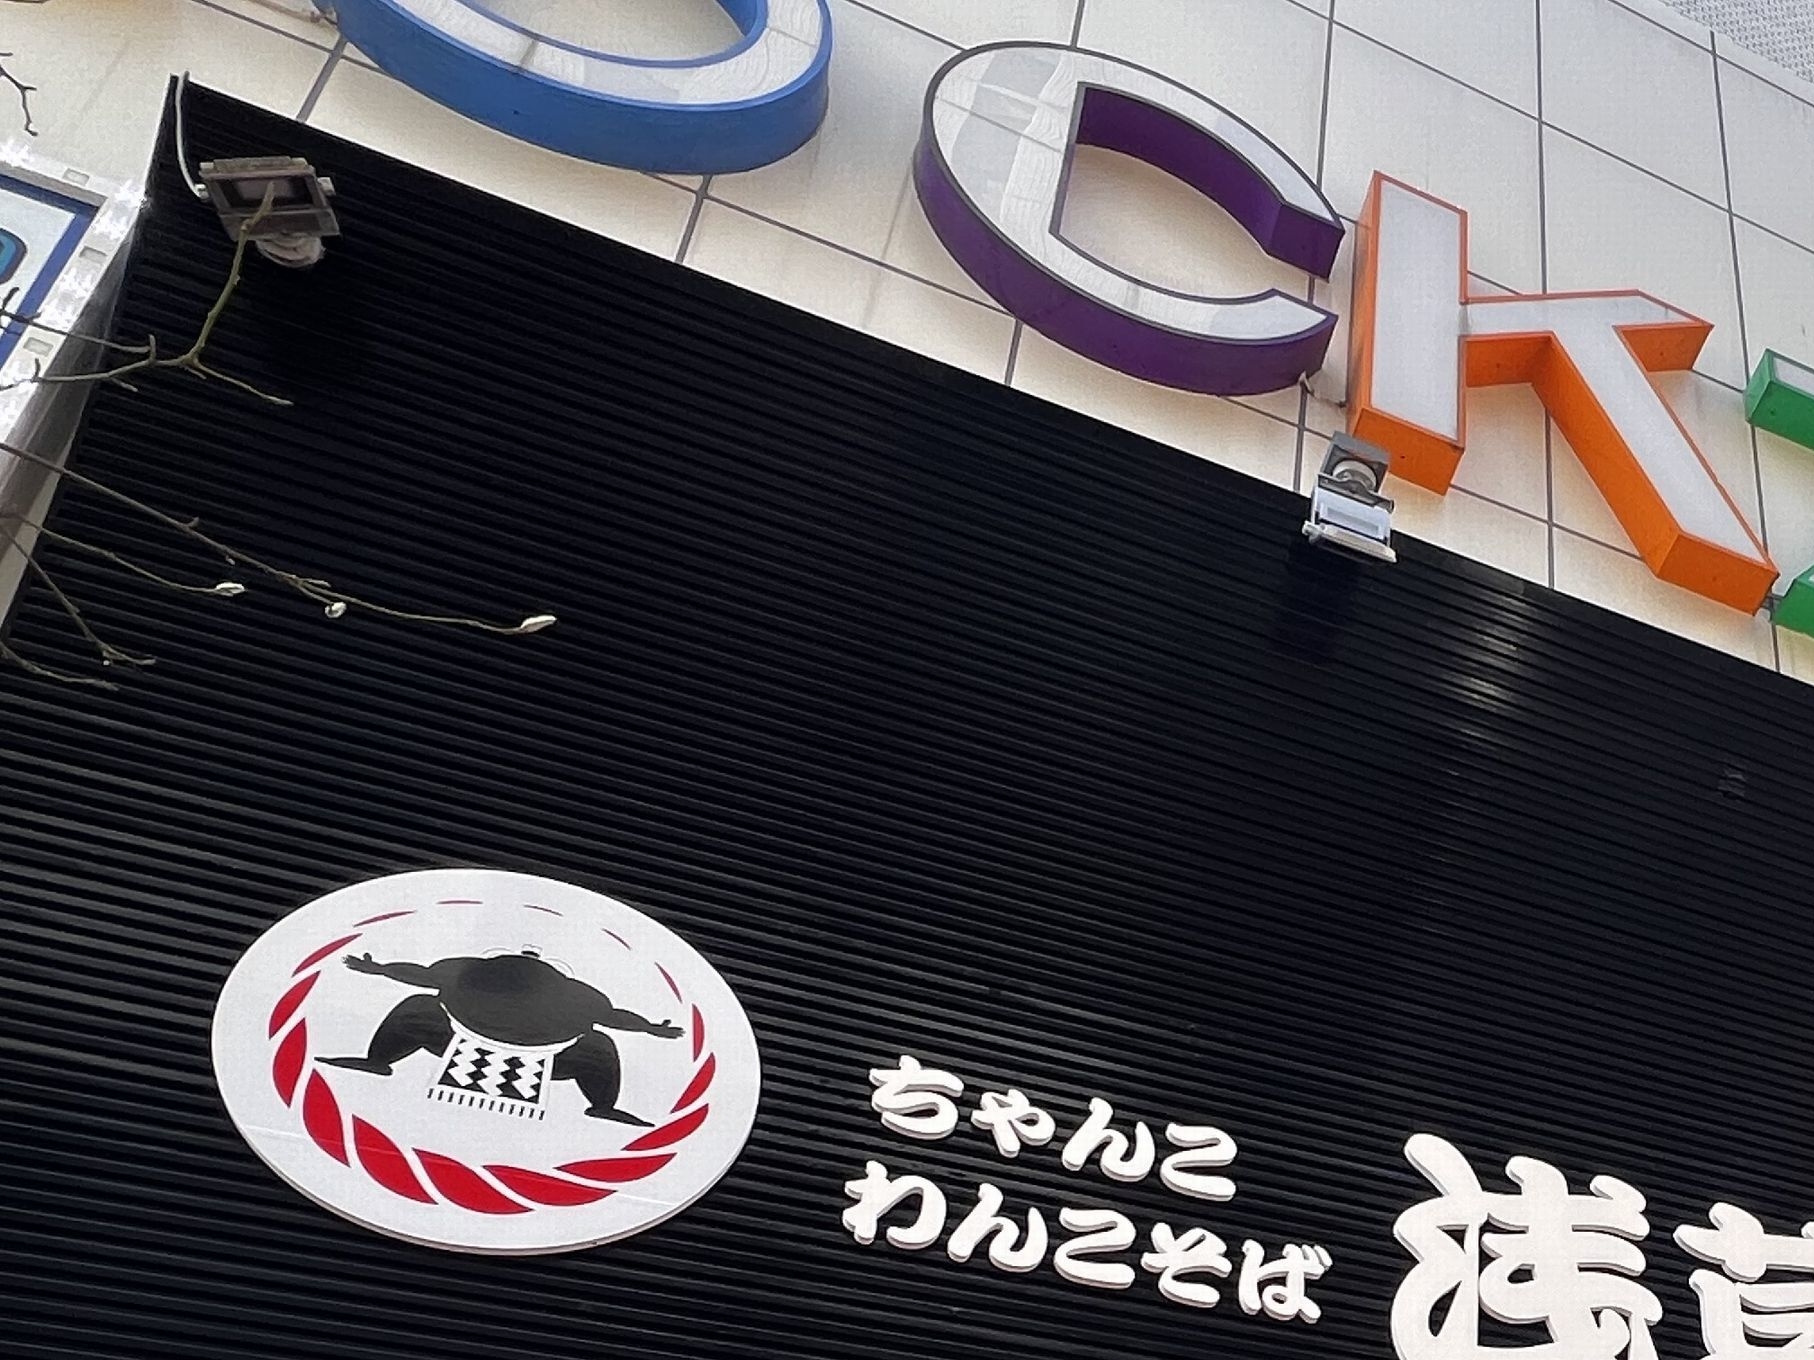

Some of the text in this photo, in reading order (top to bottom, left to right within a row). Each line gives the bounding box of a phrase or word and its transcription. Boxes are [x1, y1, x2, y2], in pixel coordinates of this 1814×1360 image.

[868, 1055, 1238, 1201] ちゃんこ
[842, 1160, 1333, 1324] わんこそば
